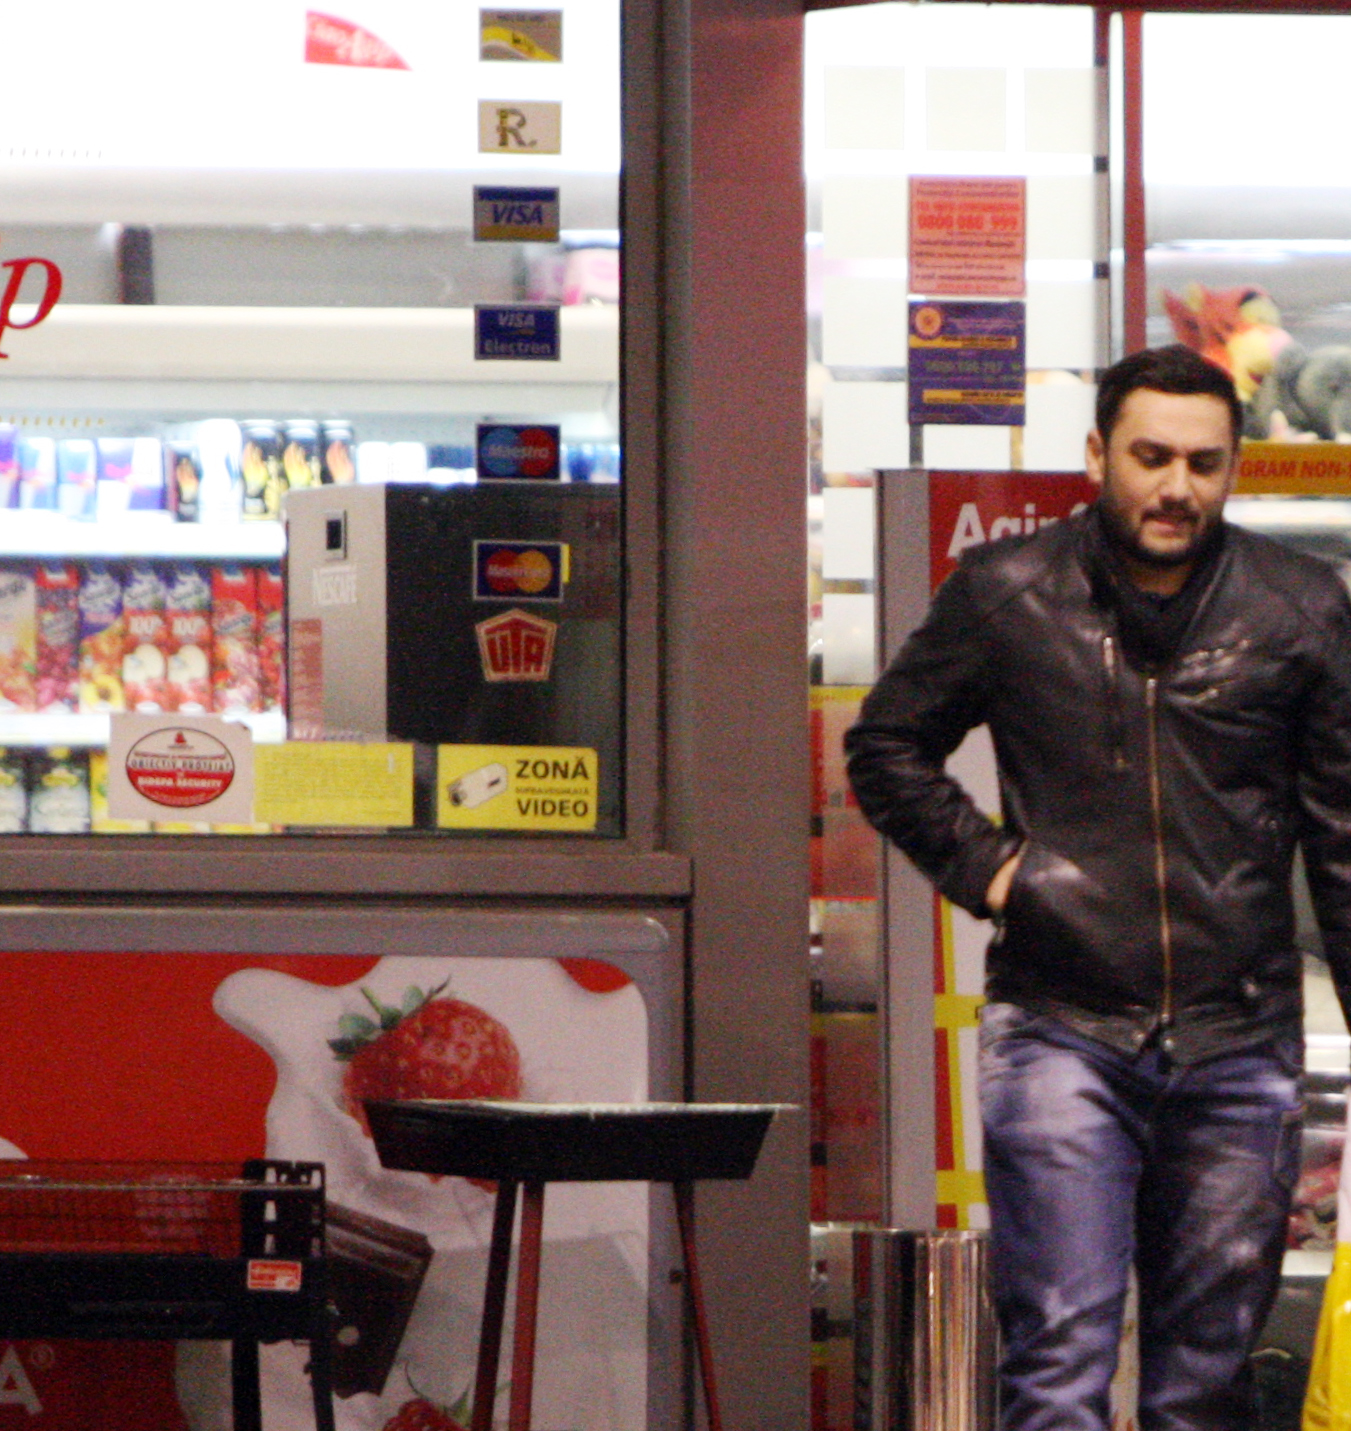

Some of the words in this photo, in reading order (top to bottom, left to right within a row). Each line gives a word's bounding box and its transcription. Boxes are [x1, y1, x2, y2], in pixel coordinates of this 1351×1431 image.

[492, 204, 543, 225] VISA
[498, 312, 535, 327] VISA
[484, 338, 551, 355] Electron
[489, 443, 549, 459] Maestro
[516, 756, 589, 779] ZONĂ
[517, 799, 588, 817] VIDEO
